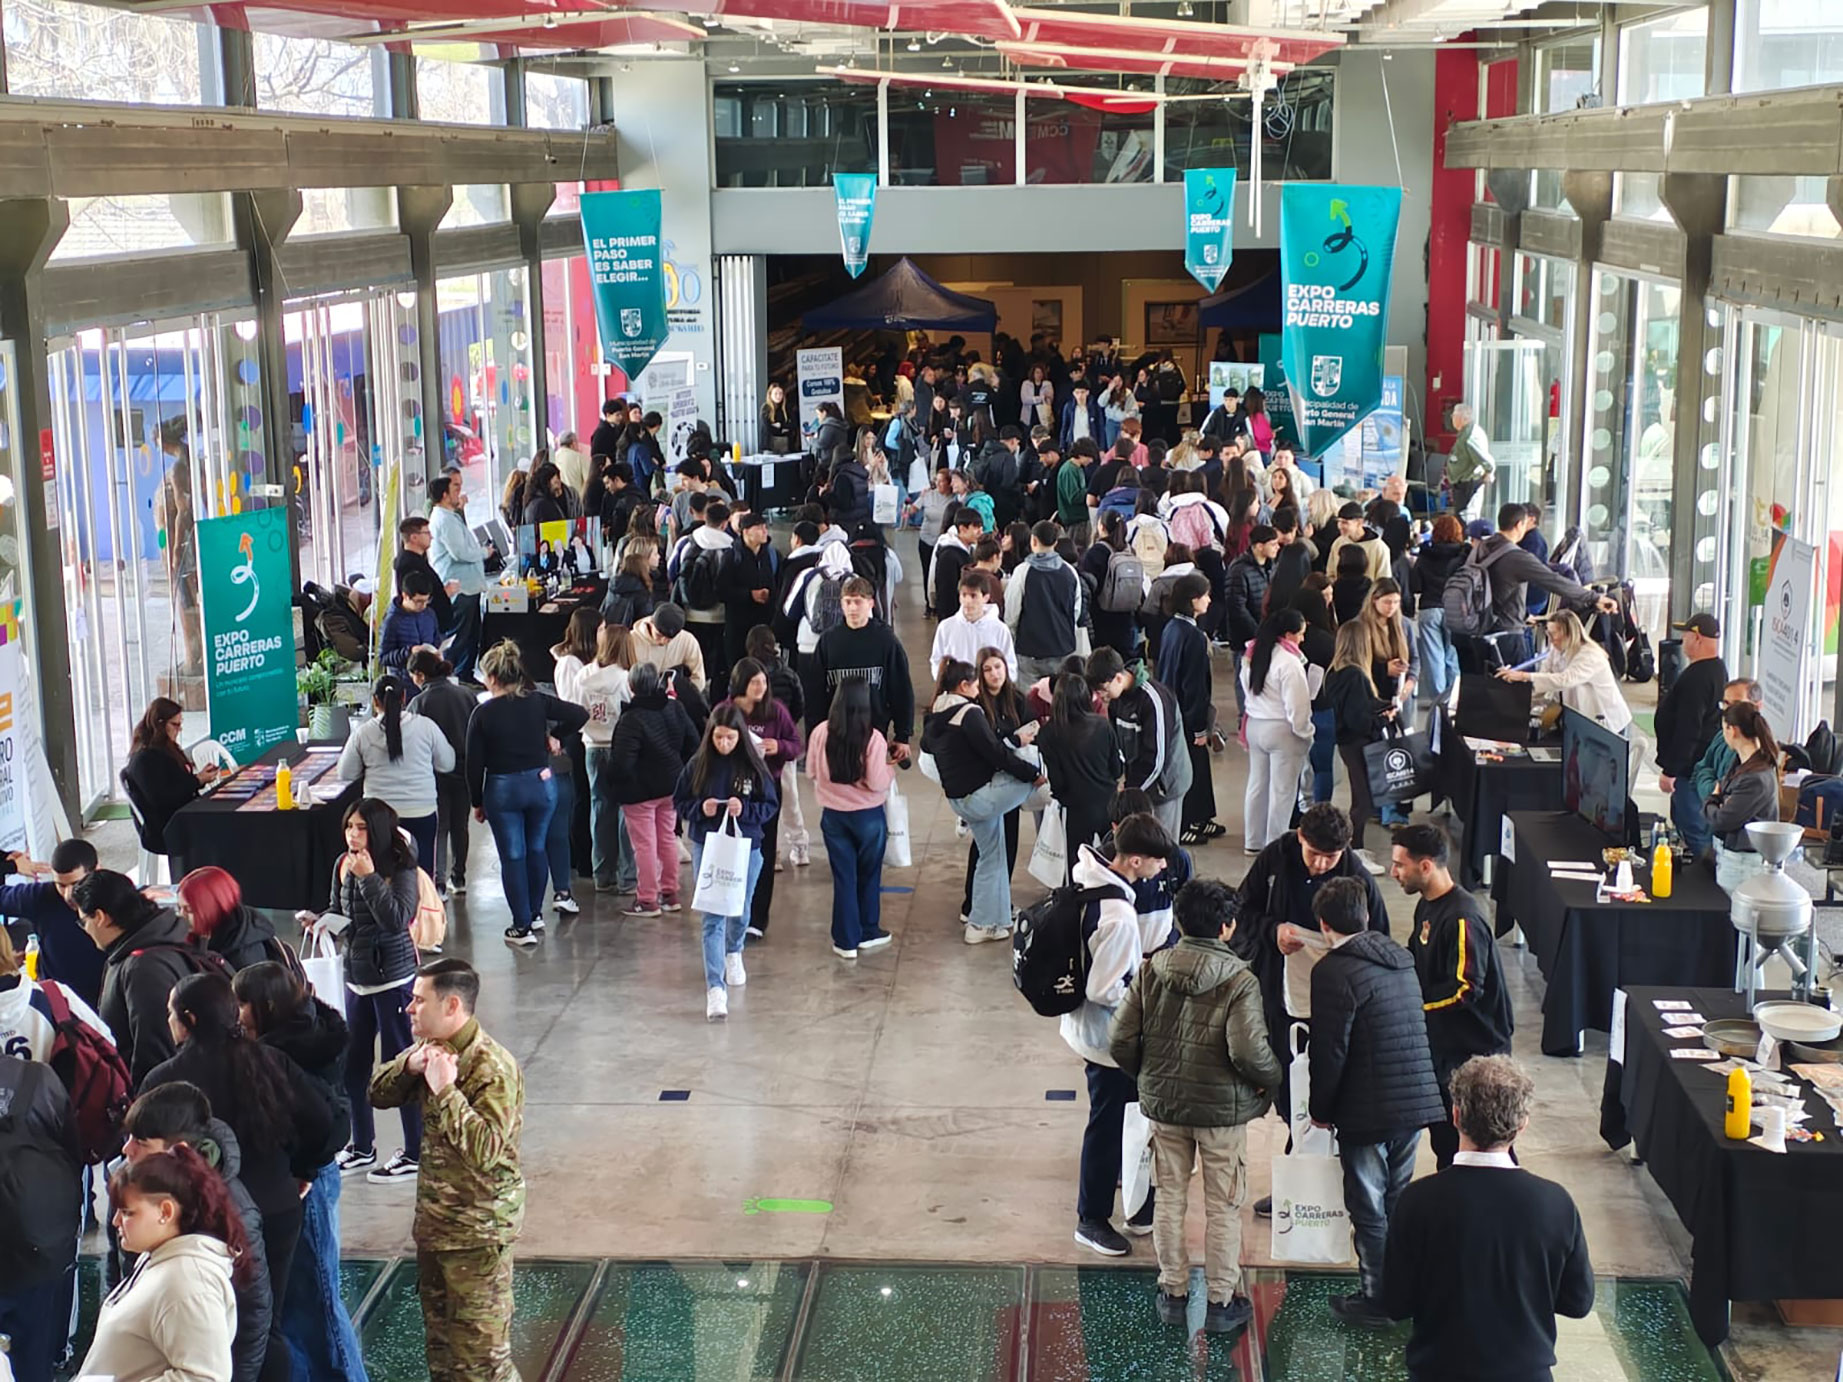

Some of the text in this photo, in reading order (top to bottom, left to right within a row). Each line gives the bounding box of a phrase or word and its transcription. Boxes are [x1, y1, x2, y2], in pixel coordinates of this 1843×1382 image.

[592, 235, 657, 249] EL PRIMER
[594, 249, 628, 260] PASO
[595, 259, 653, 272] ES SABER
[1287, 284, 1335, 299] EXPO
[1287, 298, 1380, 316] CARRERAS
[1286, 312, 1353, 329] PUERTO
[1321, 409, 1356, 420] General
[214, 629, 249, 648] EXPO
[215, 635, 282, 661] CARRERAS
[216, 653, 265, 676] PUERTO
[219, 727, 246, 745] CCM
[1294, 1204, 1321, 1213] EXPO
[1294, 1210, 1344, 1220] CARRERAS
[1294, 1219, 1330, 1228] PUERTO
